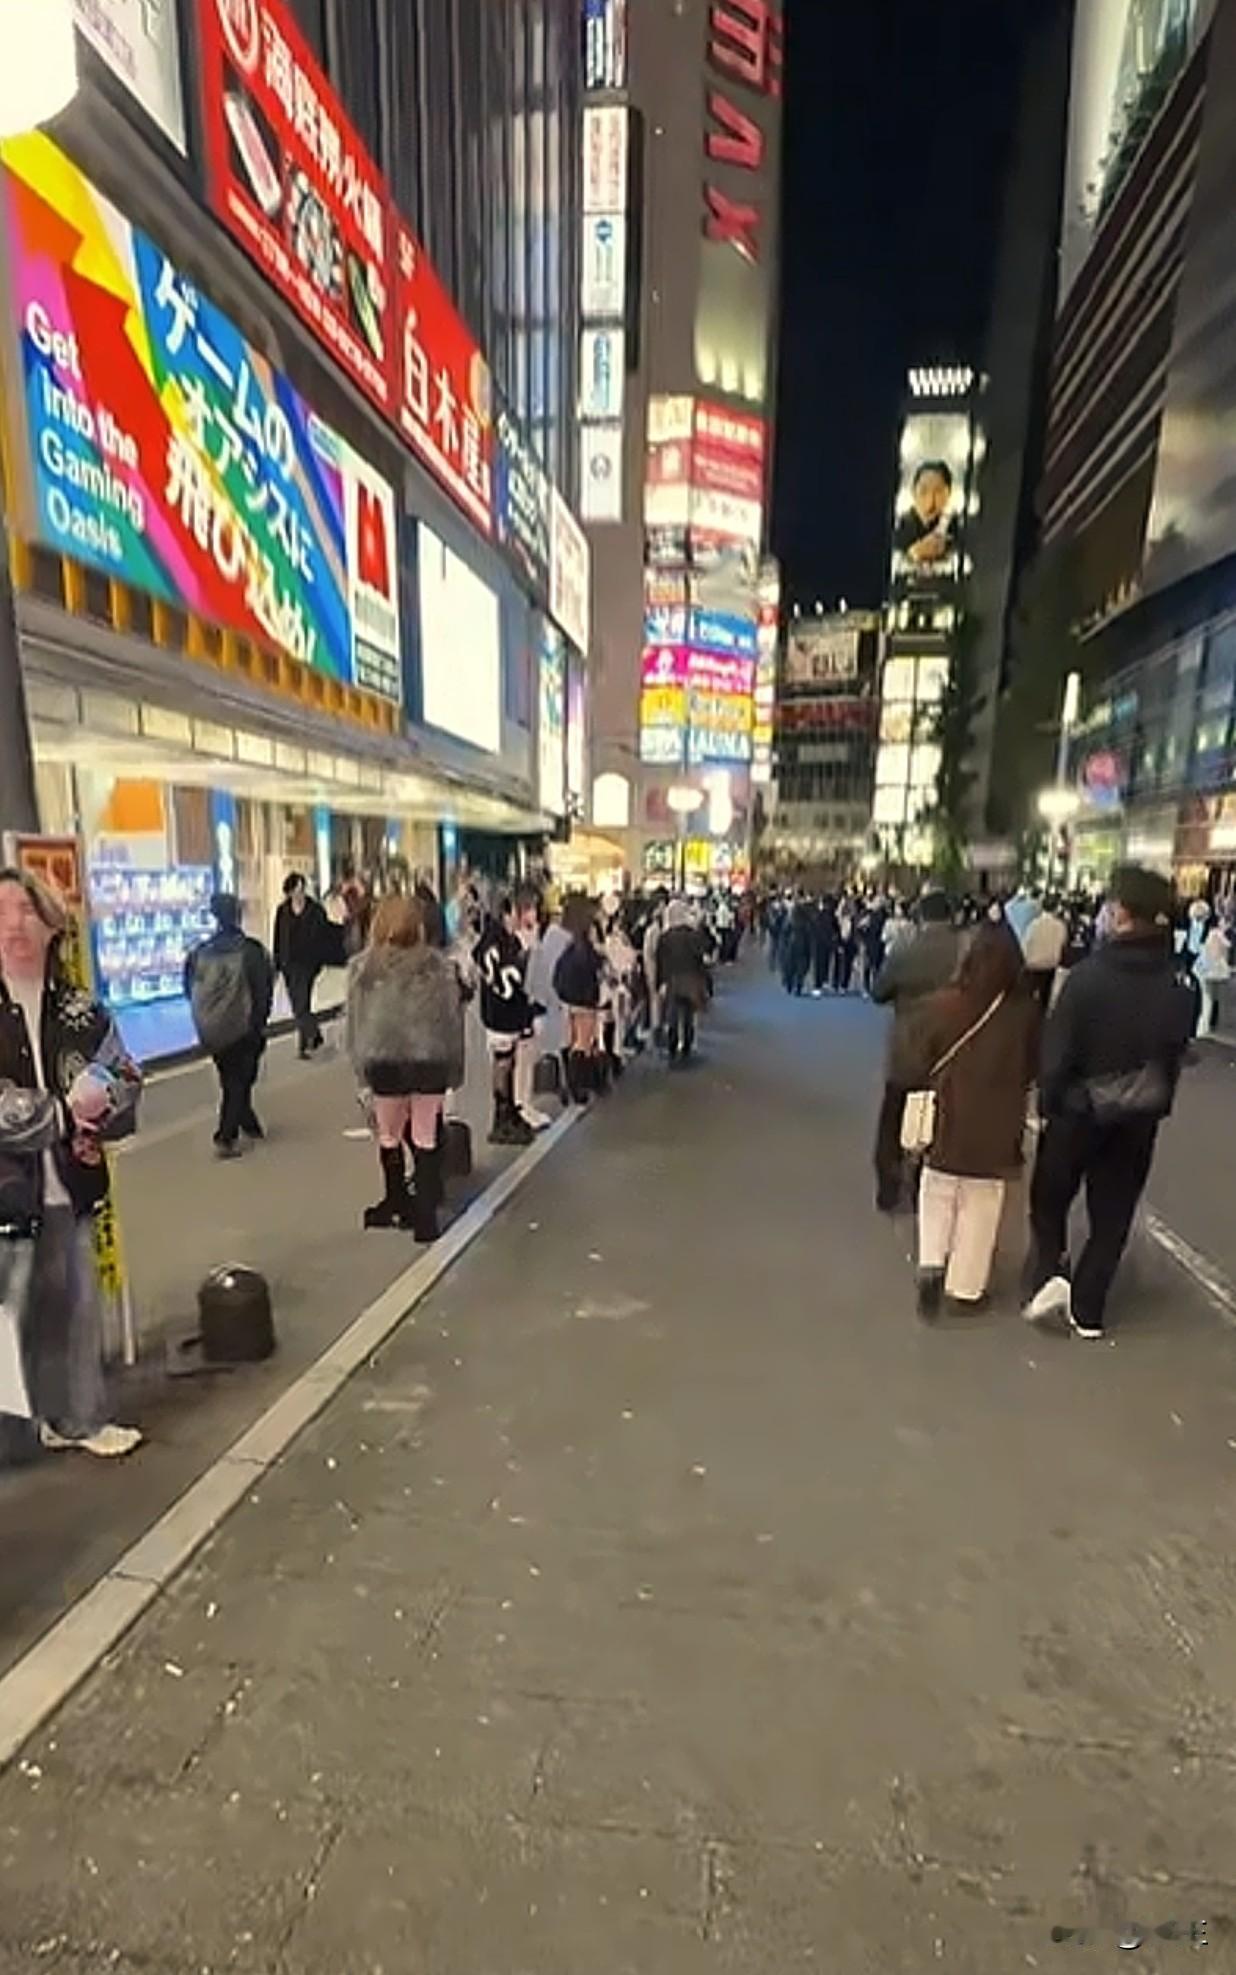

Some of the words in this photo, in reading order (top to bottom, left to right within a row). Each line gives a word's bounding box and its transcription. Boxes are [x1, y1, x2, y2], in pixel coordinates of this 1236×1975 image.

[26, 301, 82, 380] Get
[154, 258, 297, 479] ゲームの
[41, 363, 95, 440] Into
[97, 400, 139, 468] the
[41, 428, 144, 533] Gaming
[48, 485, 123, 562] Oasis
[175, 372, 314, 582] オアシスに
